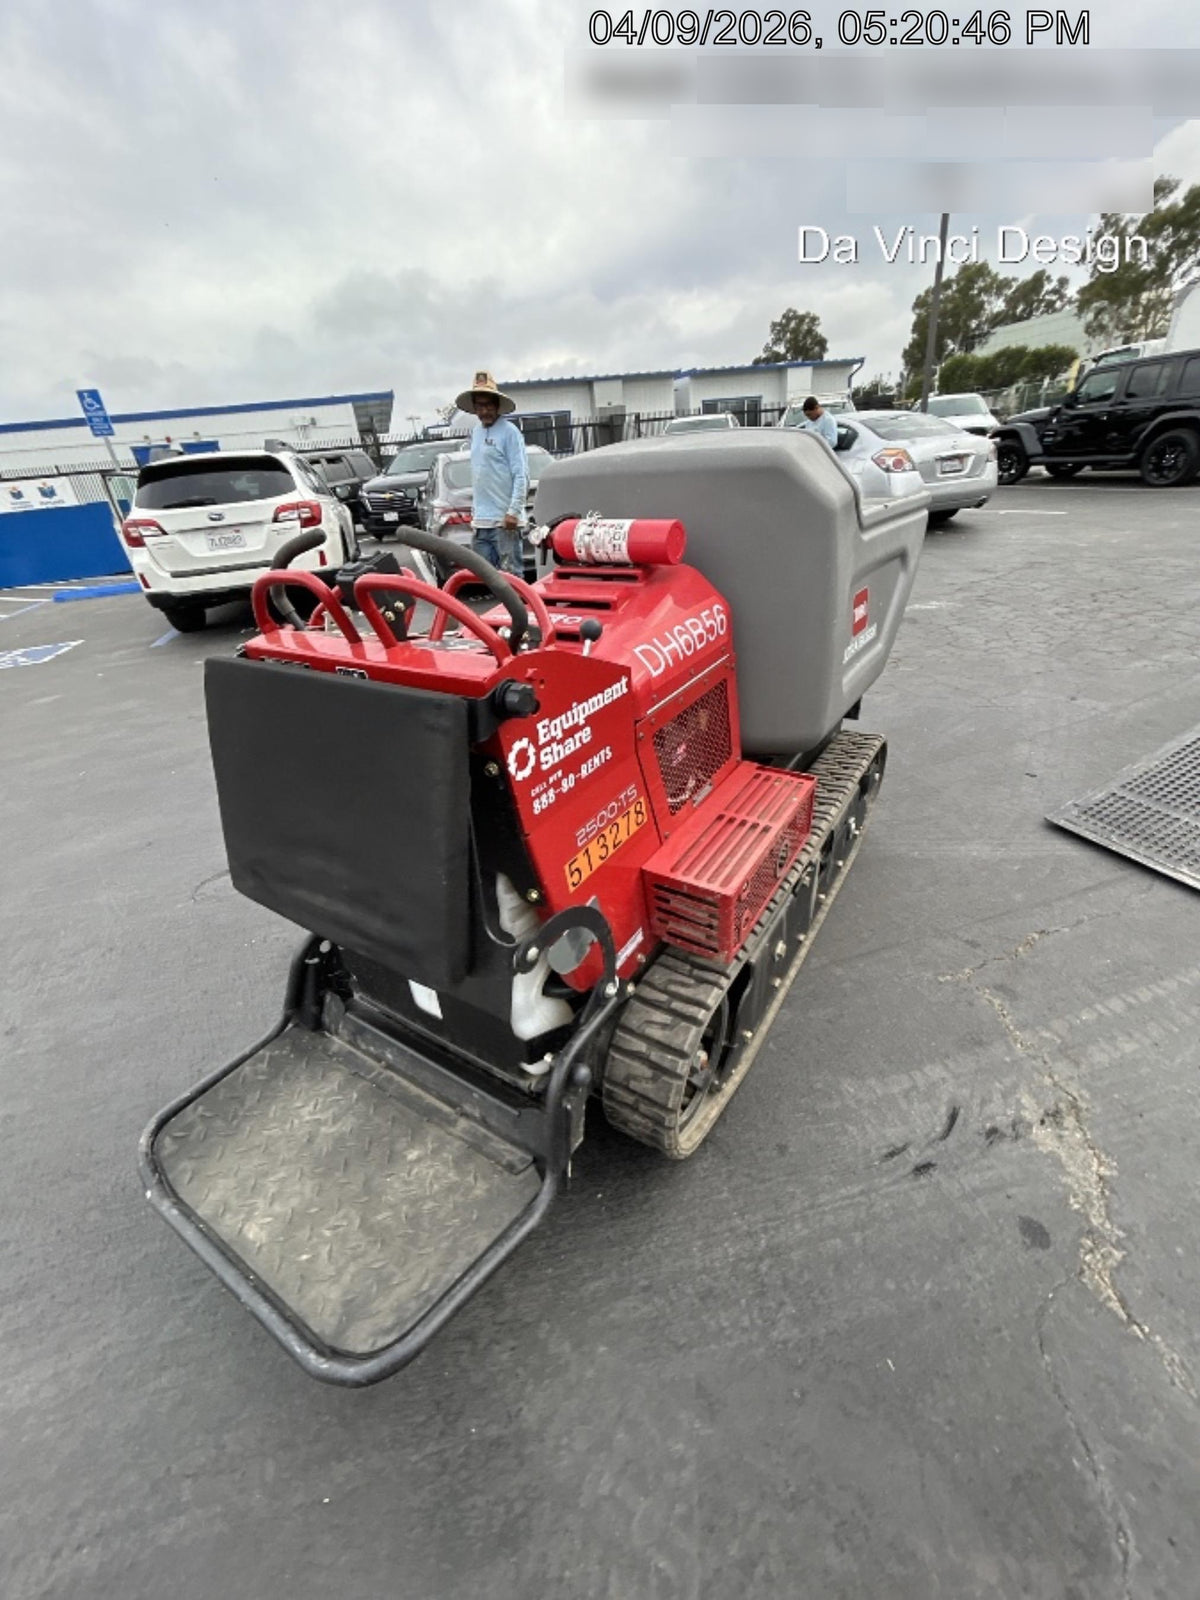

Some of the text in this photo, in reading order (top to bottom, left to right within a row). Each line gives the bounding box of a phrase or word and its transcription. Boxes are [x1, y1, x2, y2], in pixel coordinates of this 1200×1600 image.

[633, 603, 727, 678] DH6B56
[536, 675, 629, 746] Equipment
[540, 725, 593, 771] Share
[568, 800, 646, 888] 513278
